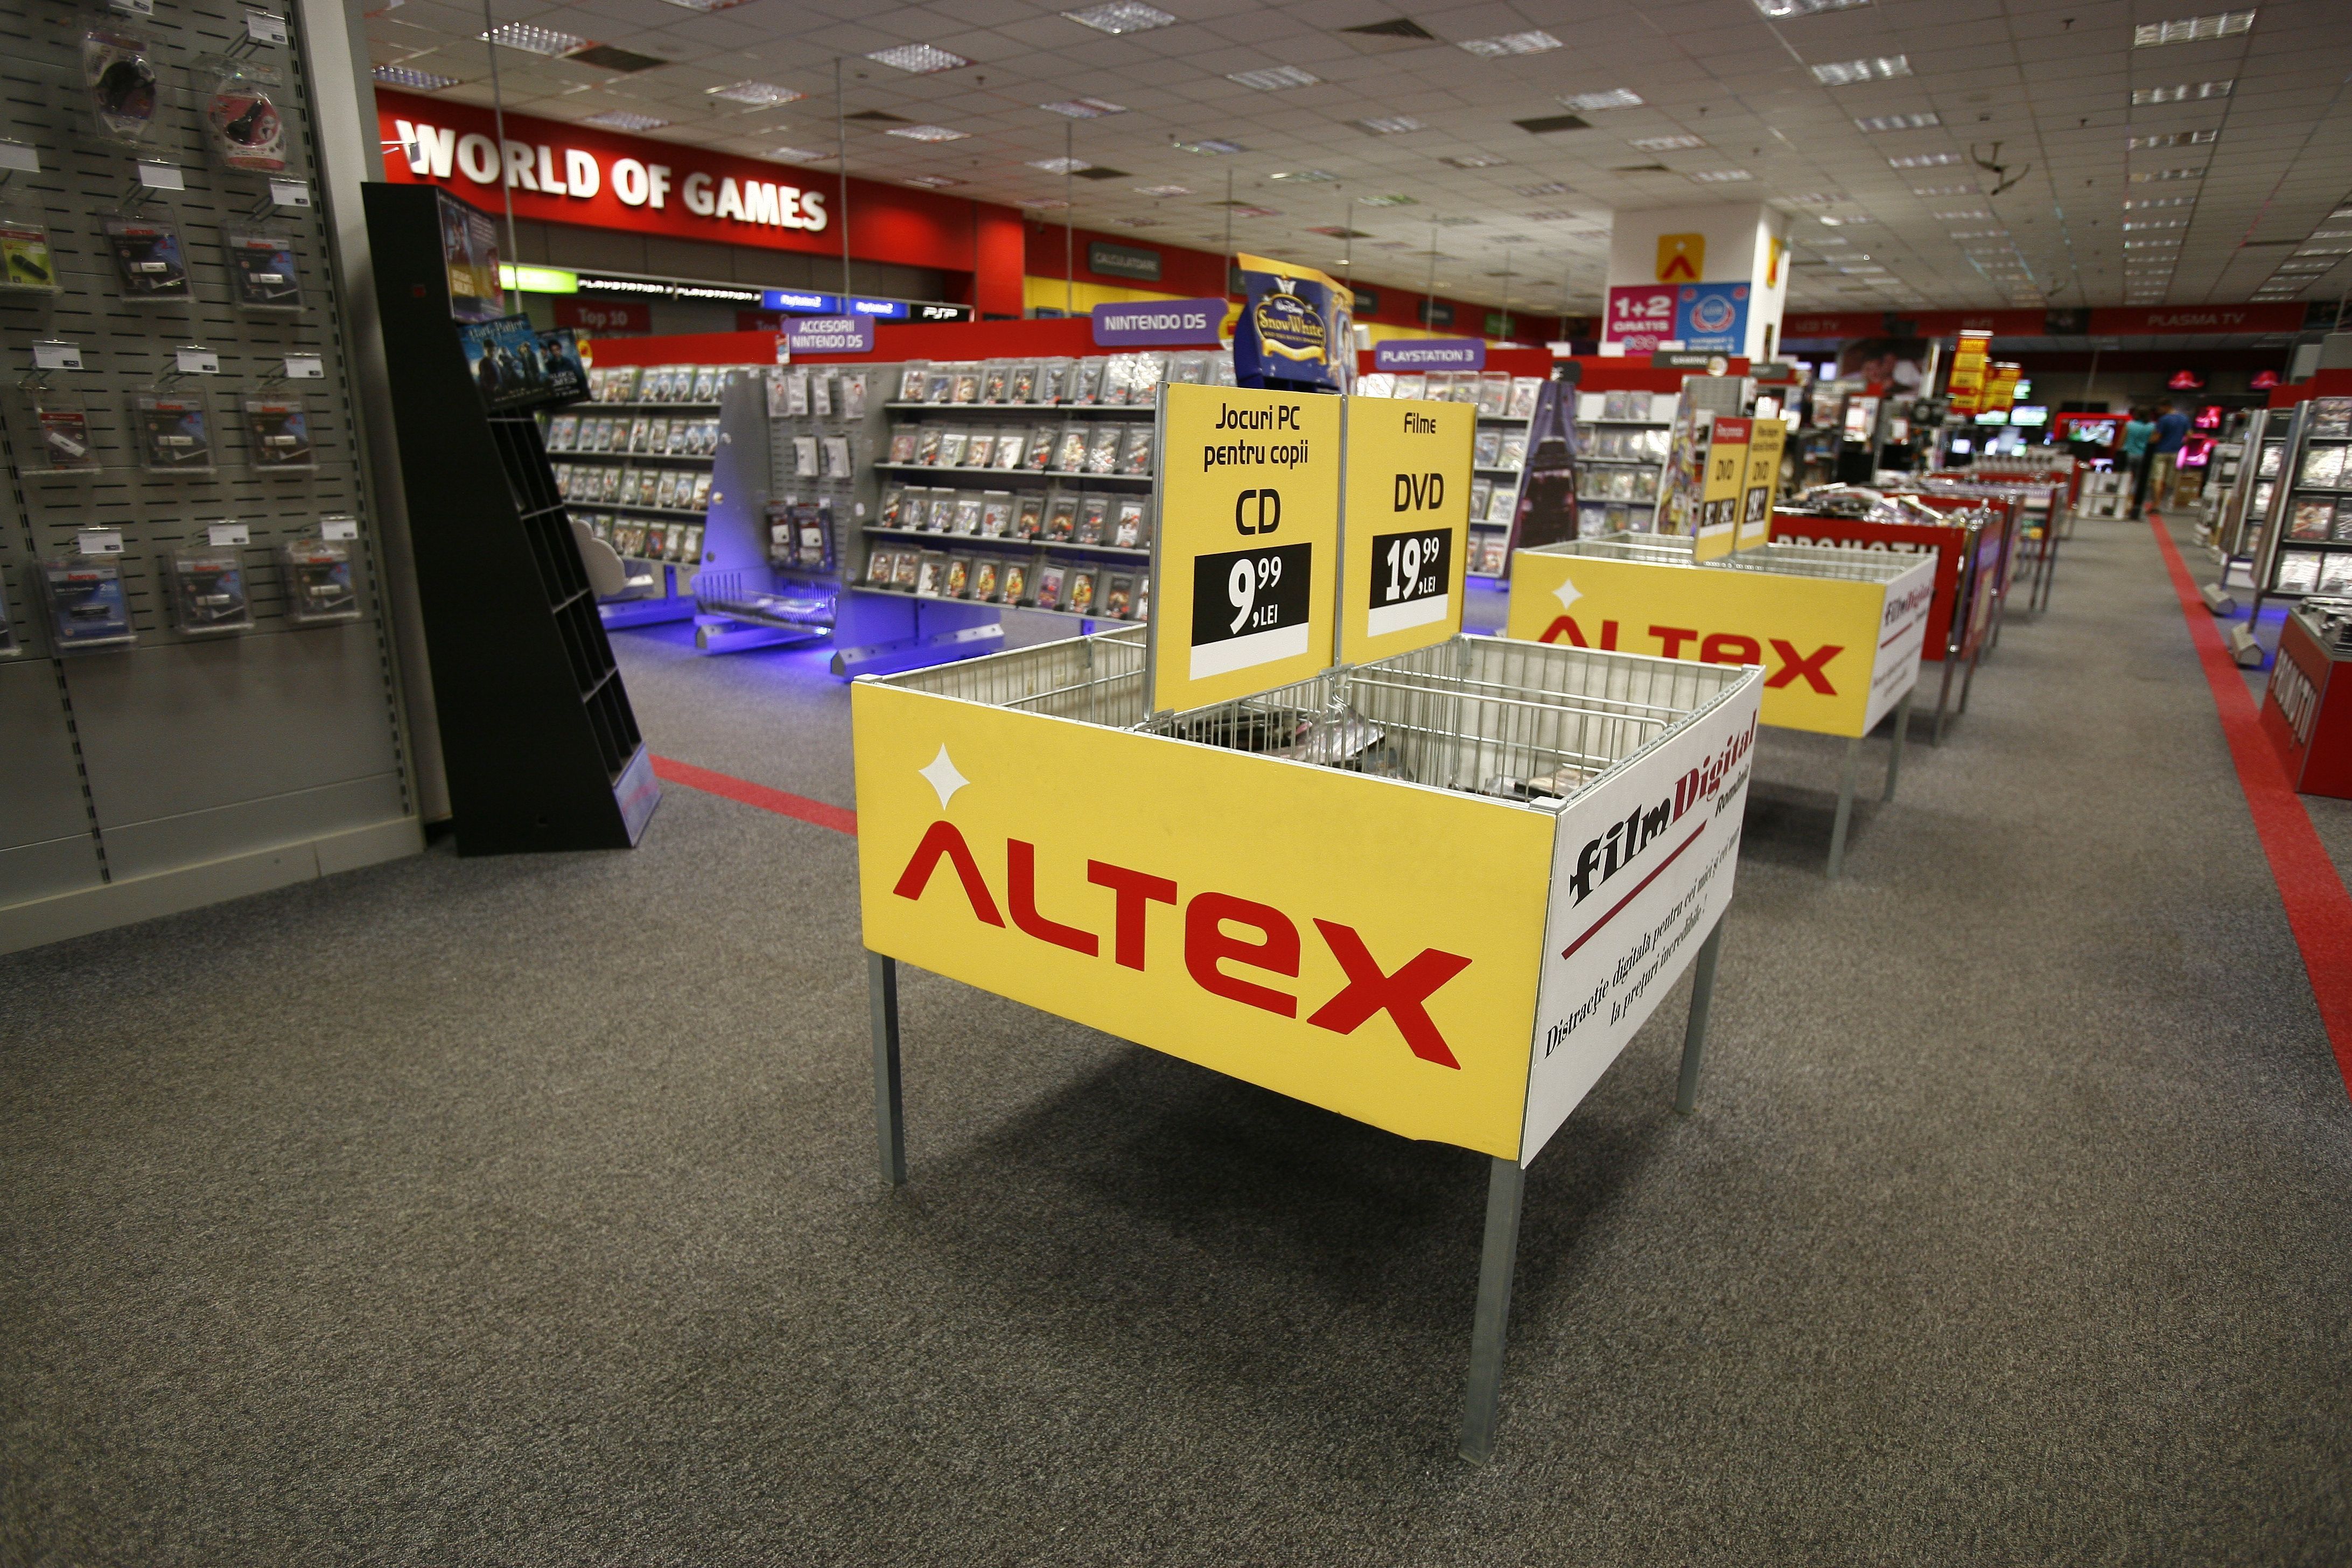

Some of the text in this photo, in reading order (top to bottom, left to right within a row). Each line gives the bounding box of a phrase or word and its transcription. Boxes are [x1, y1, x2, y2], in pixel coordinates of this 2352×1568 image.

[395, 119, 828, 232] WORLD OF GAMES
[577, 307, 628, 328] Top 10
[922, 306, 958, 319] PSP
[1614, 295, 1672, 318] 1+2
[799, 319, 855, 334] ACCESORII
[1104, 313, 1207, 331] NINTENDO DS
[1612, 320, 1669, 333] GRATIS
[2147, 311, 2248, 326] PLASMA TV
[792, 334, 863, 348] NINTENDO DS
[1381, 349, 1475, 363] PLAYSTATION 3
[1215, 402, 1301, 431] Jocuri PC
[1404, 412, 1437, 434] Filme
[1203, 439, 1309, 473] pentru copii
[1394, 473, 1445, 512] DVD
[1235, 488, 1282, 536] CD
[1651, 900, 1683, 952] pentru
[1609, 1000, 1621, 1027] la
